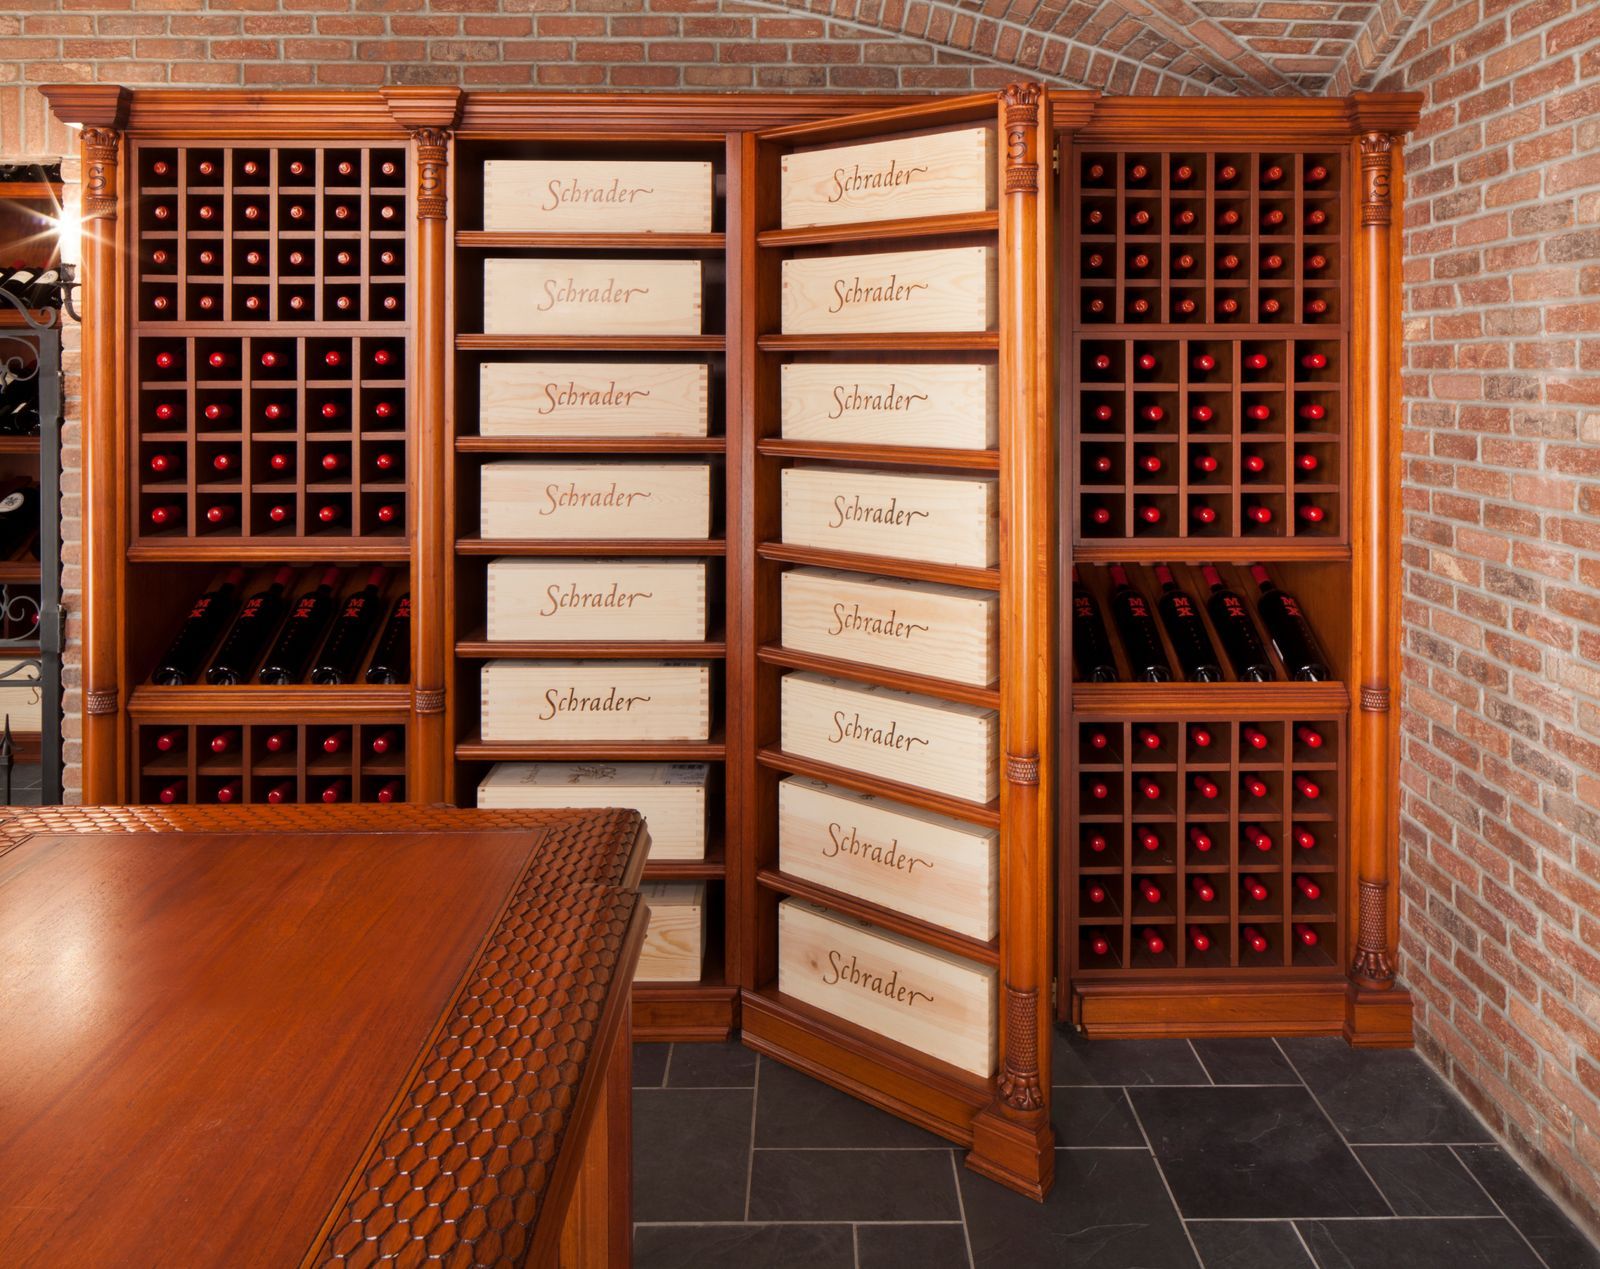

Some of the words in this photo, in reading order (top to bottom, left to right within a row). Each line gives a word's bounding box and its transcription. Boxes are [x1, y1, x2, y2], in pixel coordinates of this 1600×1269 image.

[1007, 131, 1027, 159] S
[87, 166, 106, 190] S
[420, 166, 442, 191] S
[542, 179, 654, 211] Schrader
[828, 159, 929, 203] Schrader
[1370, 174, 1389, 198] S
[537, 279, 649, 312] Schrader
[828, 274, 929, 313] Schrader
[538, 381, 650, 415] Schrader
[828, 384, 929, 419] Schrader
[539, 483, 652, 516] Schrader
[828, 495, 930, 528] Schrader
[540, 583, 653, 617] Schrader
[828, 603, 929, 639] Schrader
[539, 687, 651, 721] Schrader
[828, 710, 930, 752] Schrader
[822, 822, 934, 873] Schrader
[822, 949, 934, 1006] Schrader
